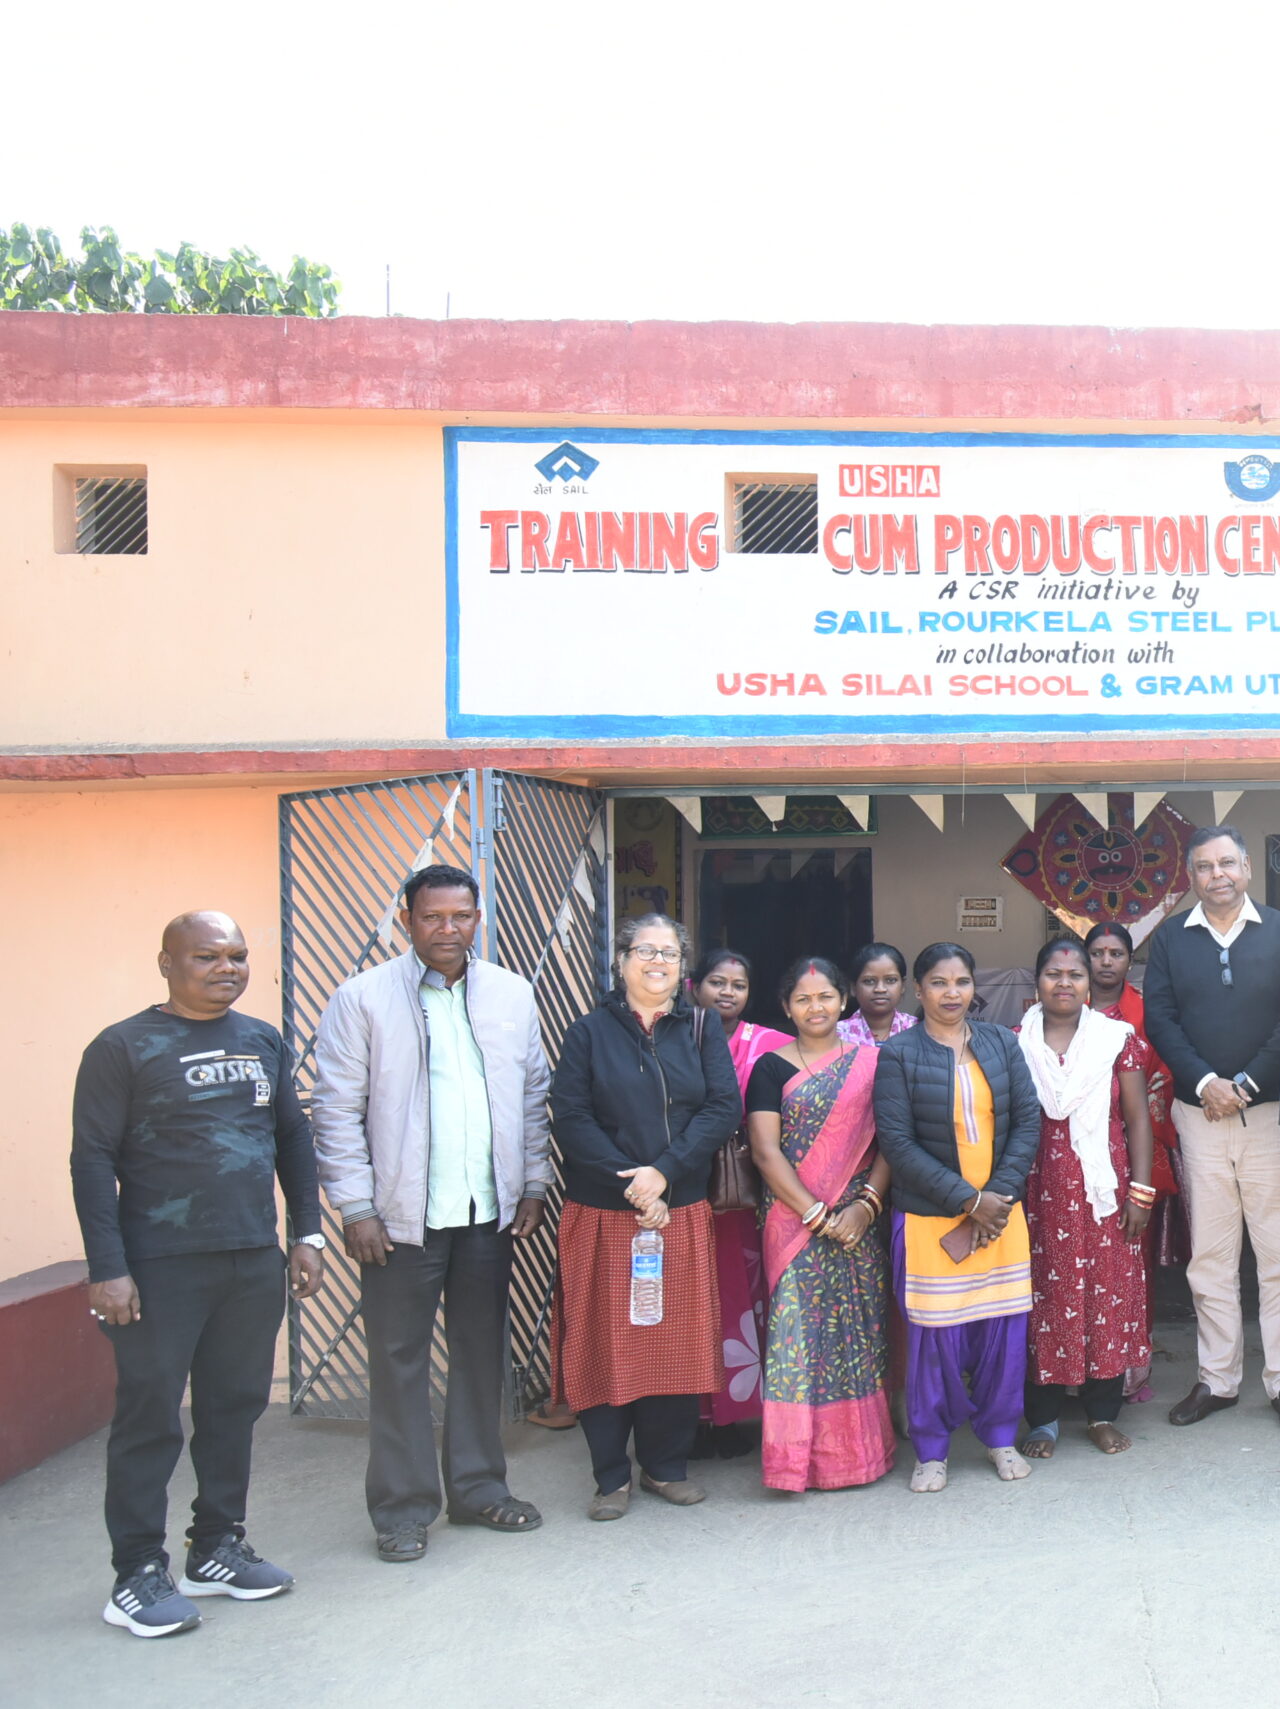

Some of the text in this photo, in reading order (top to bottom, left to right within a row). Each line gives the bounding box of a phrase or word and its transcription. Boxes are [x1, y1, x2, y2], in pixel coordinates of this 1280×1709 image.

[563, 485, 589, 495] SAIL
[842, 466, 939, 496] USHA
[480, 510, 719, 574] TRAINING
[823, 514, 920, 575] CUM
[934, 514, 1208, 576] PRODUCTION
[938, 578, 1200, 608] A CSR initiative by
[919, 611, 1112, 632] ROURKELA
[1128, 610, 1232, 632] STEEL
[936, 641, 1173, 664] in collaboration with
[717, 673, 827, 696] USHA
[842, 674, 932, 696] SILAI
[949, 674, 1088, 696] SCHOOL
[1101, 673, 1122, 698] &
[1136, 675, 1232, 695] GRAM
[185, 1060, 269, 1087] CRYSTAL
